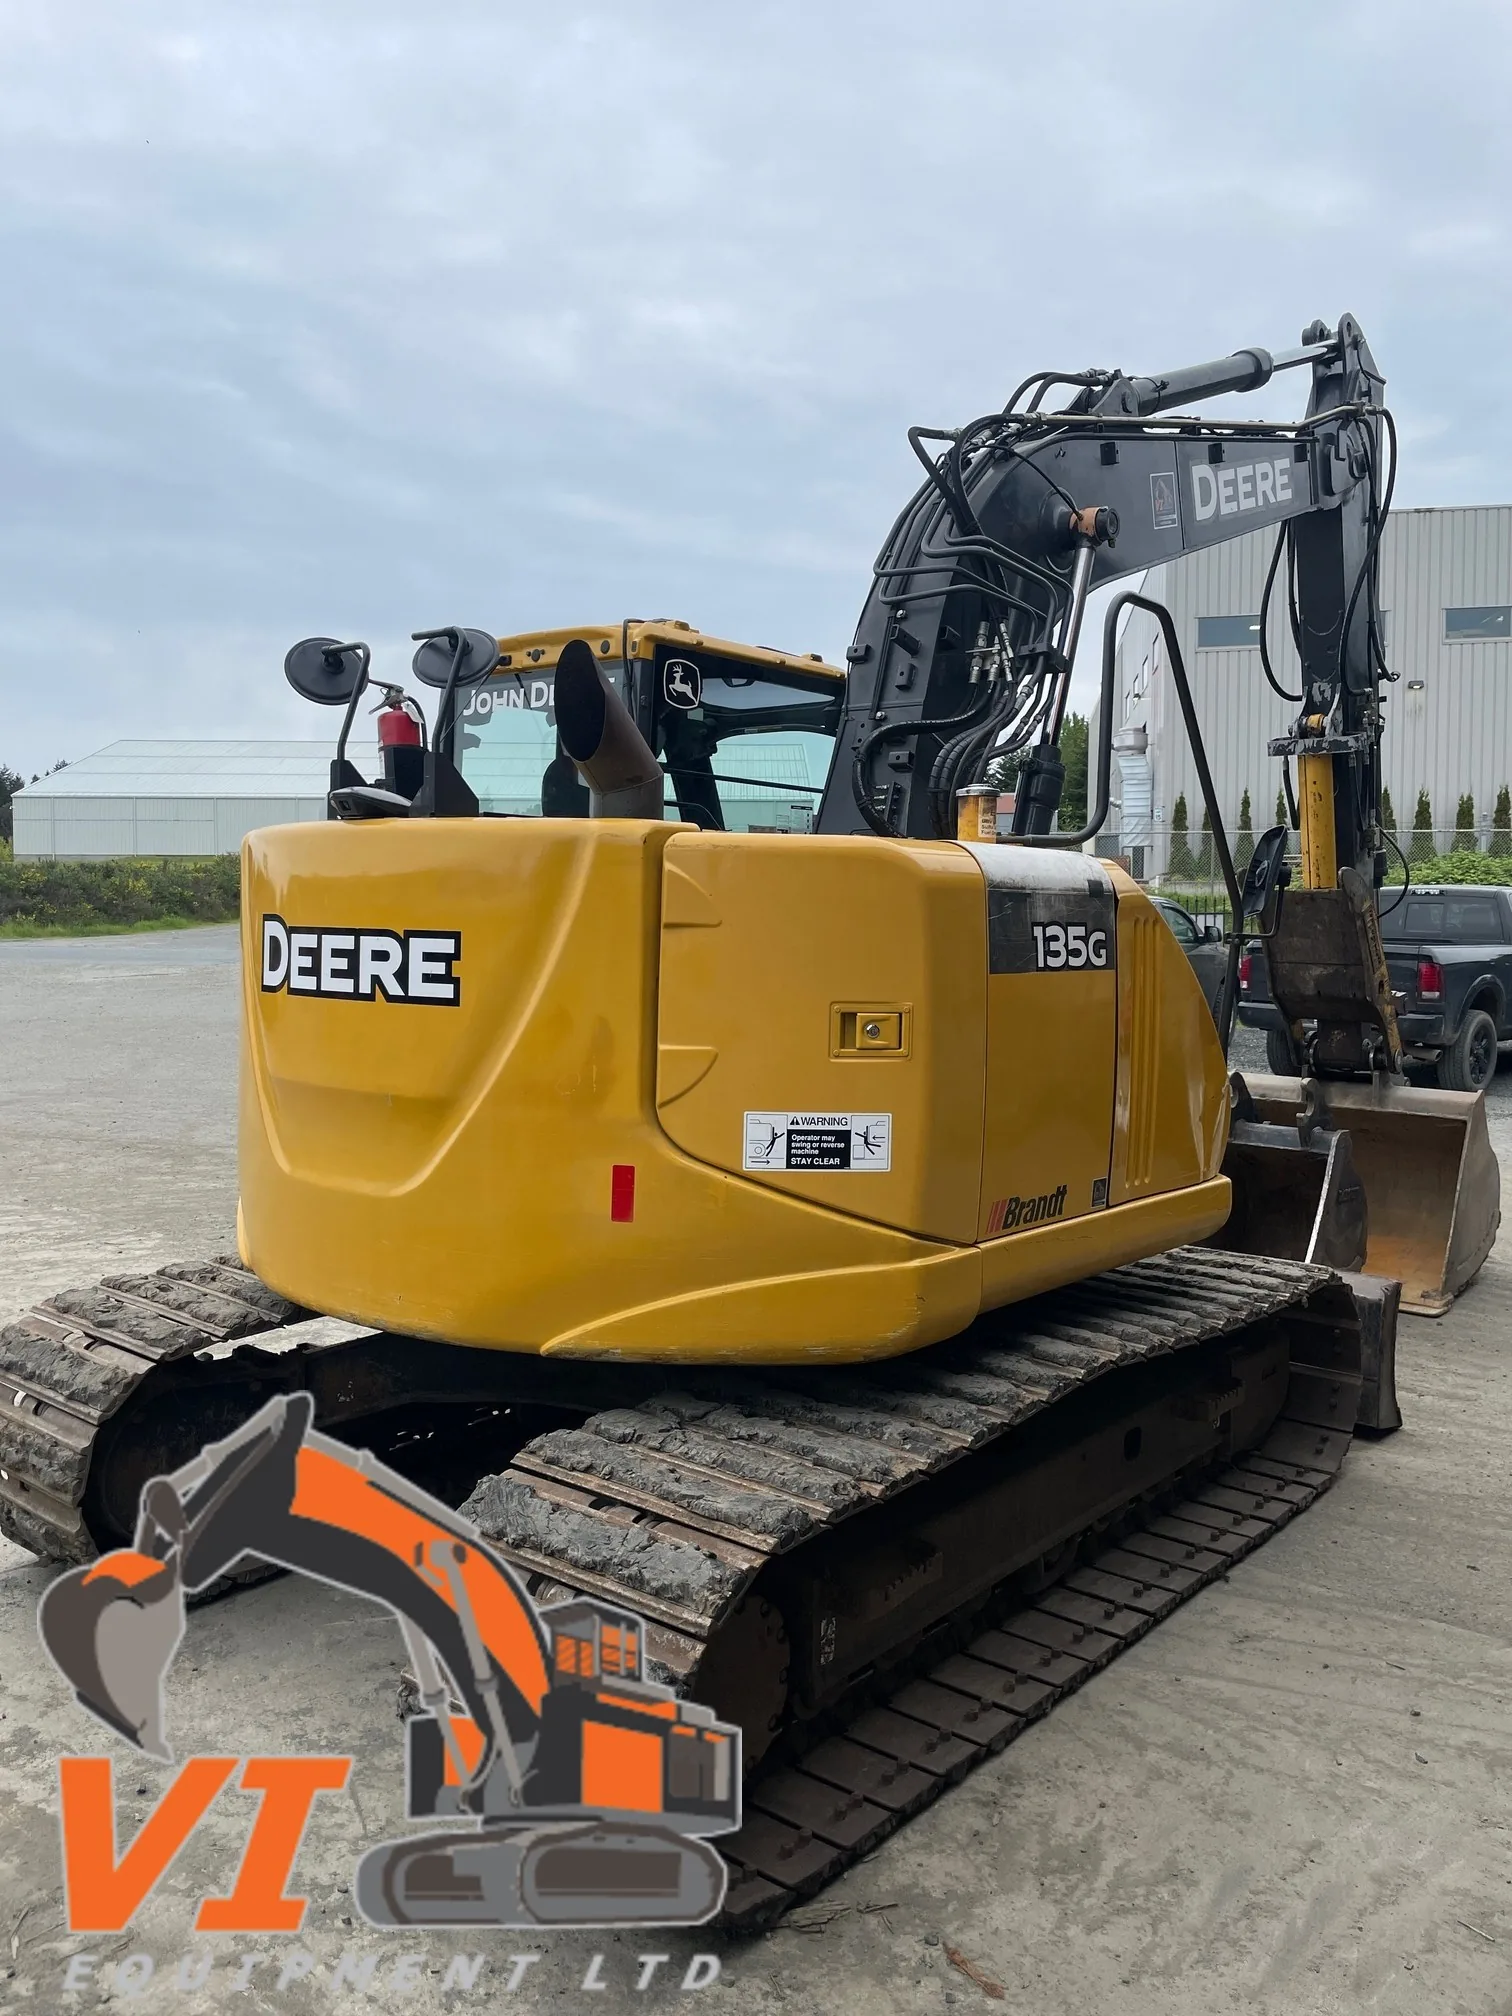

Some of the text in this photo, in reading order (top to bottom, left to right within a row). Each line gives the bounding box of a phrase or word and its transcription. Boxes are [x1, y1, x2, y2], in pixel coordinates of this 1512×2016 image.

[1191, 457, 1293, 521] DEERE
[463, 688, 525, 716] JOHN
[262, 919, 457, 1000] DEERE
[1032, 924, 1107, 968] 135G
[800, 1116, 848, 1126] WARNING
[791, 1134, 820, 1142] Operator
[791, 1141, 811, 1149] swing
[790, 1157, 840, 1165] STAY CLEAR
[1001, 1184, 1068, 1230] Brandt
